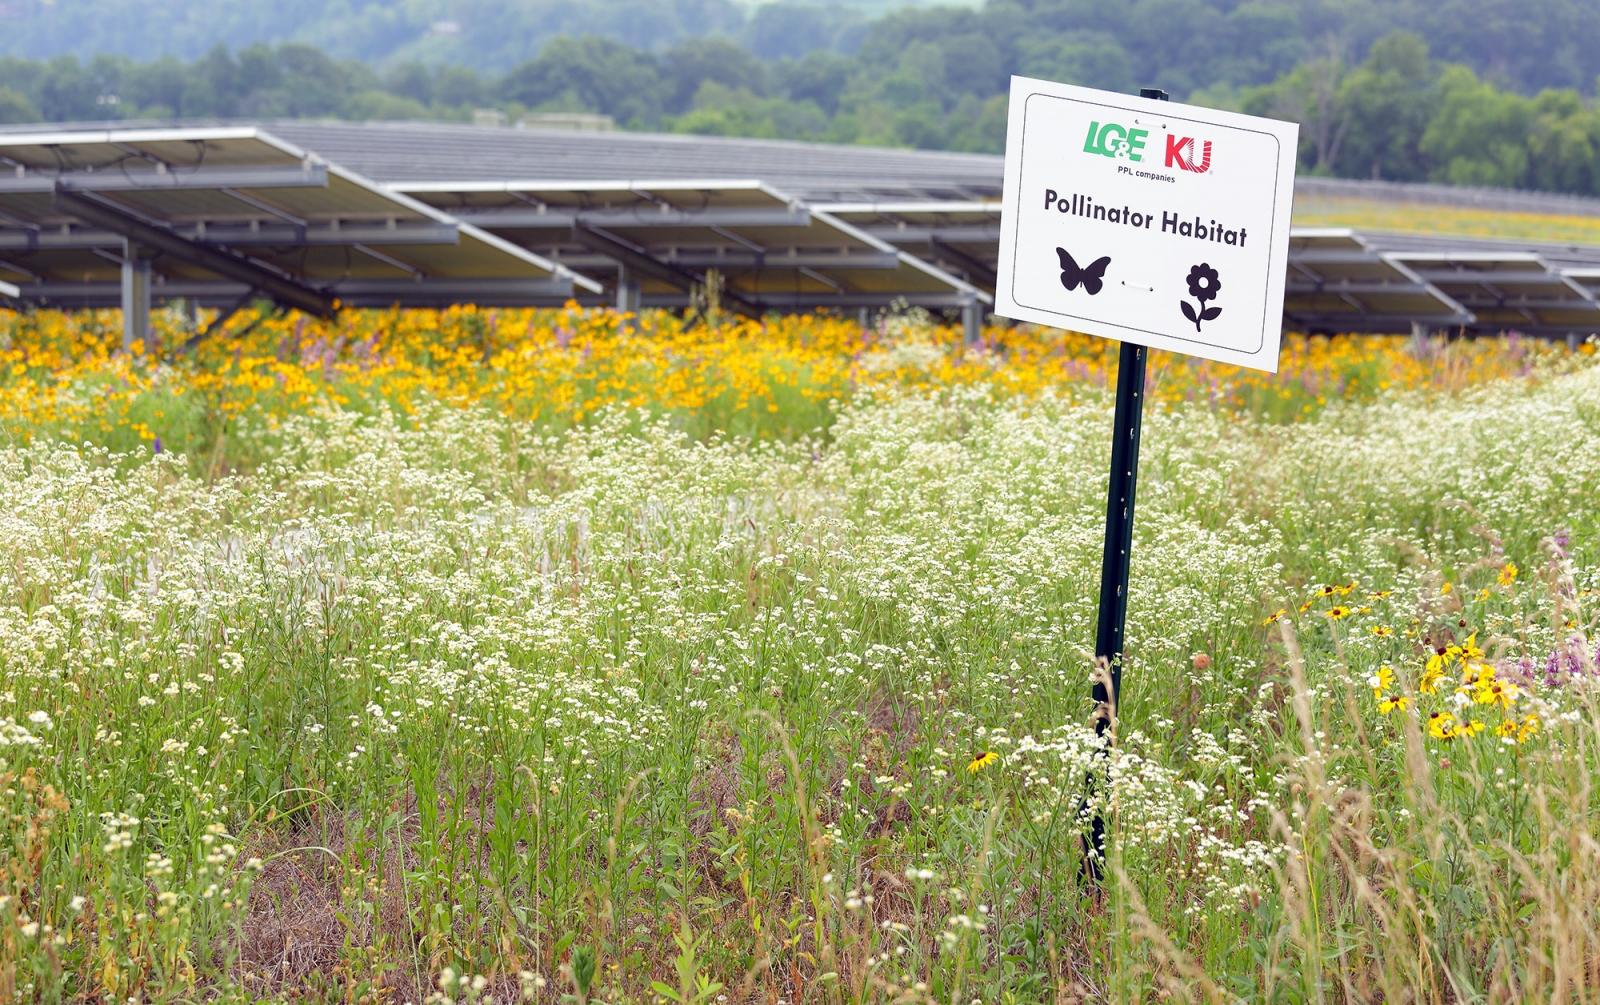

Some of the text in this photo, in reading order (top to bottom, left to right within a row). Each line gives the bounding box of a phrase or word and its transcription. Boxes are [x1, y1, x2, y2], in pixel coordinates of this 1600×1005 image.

[1083, 121, 1213, 174] LG&E KU
[1117, 165, 1176, 183] PPL companies
[1044, 188, 1248, 248] Pollinator Habitat
